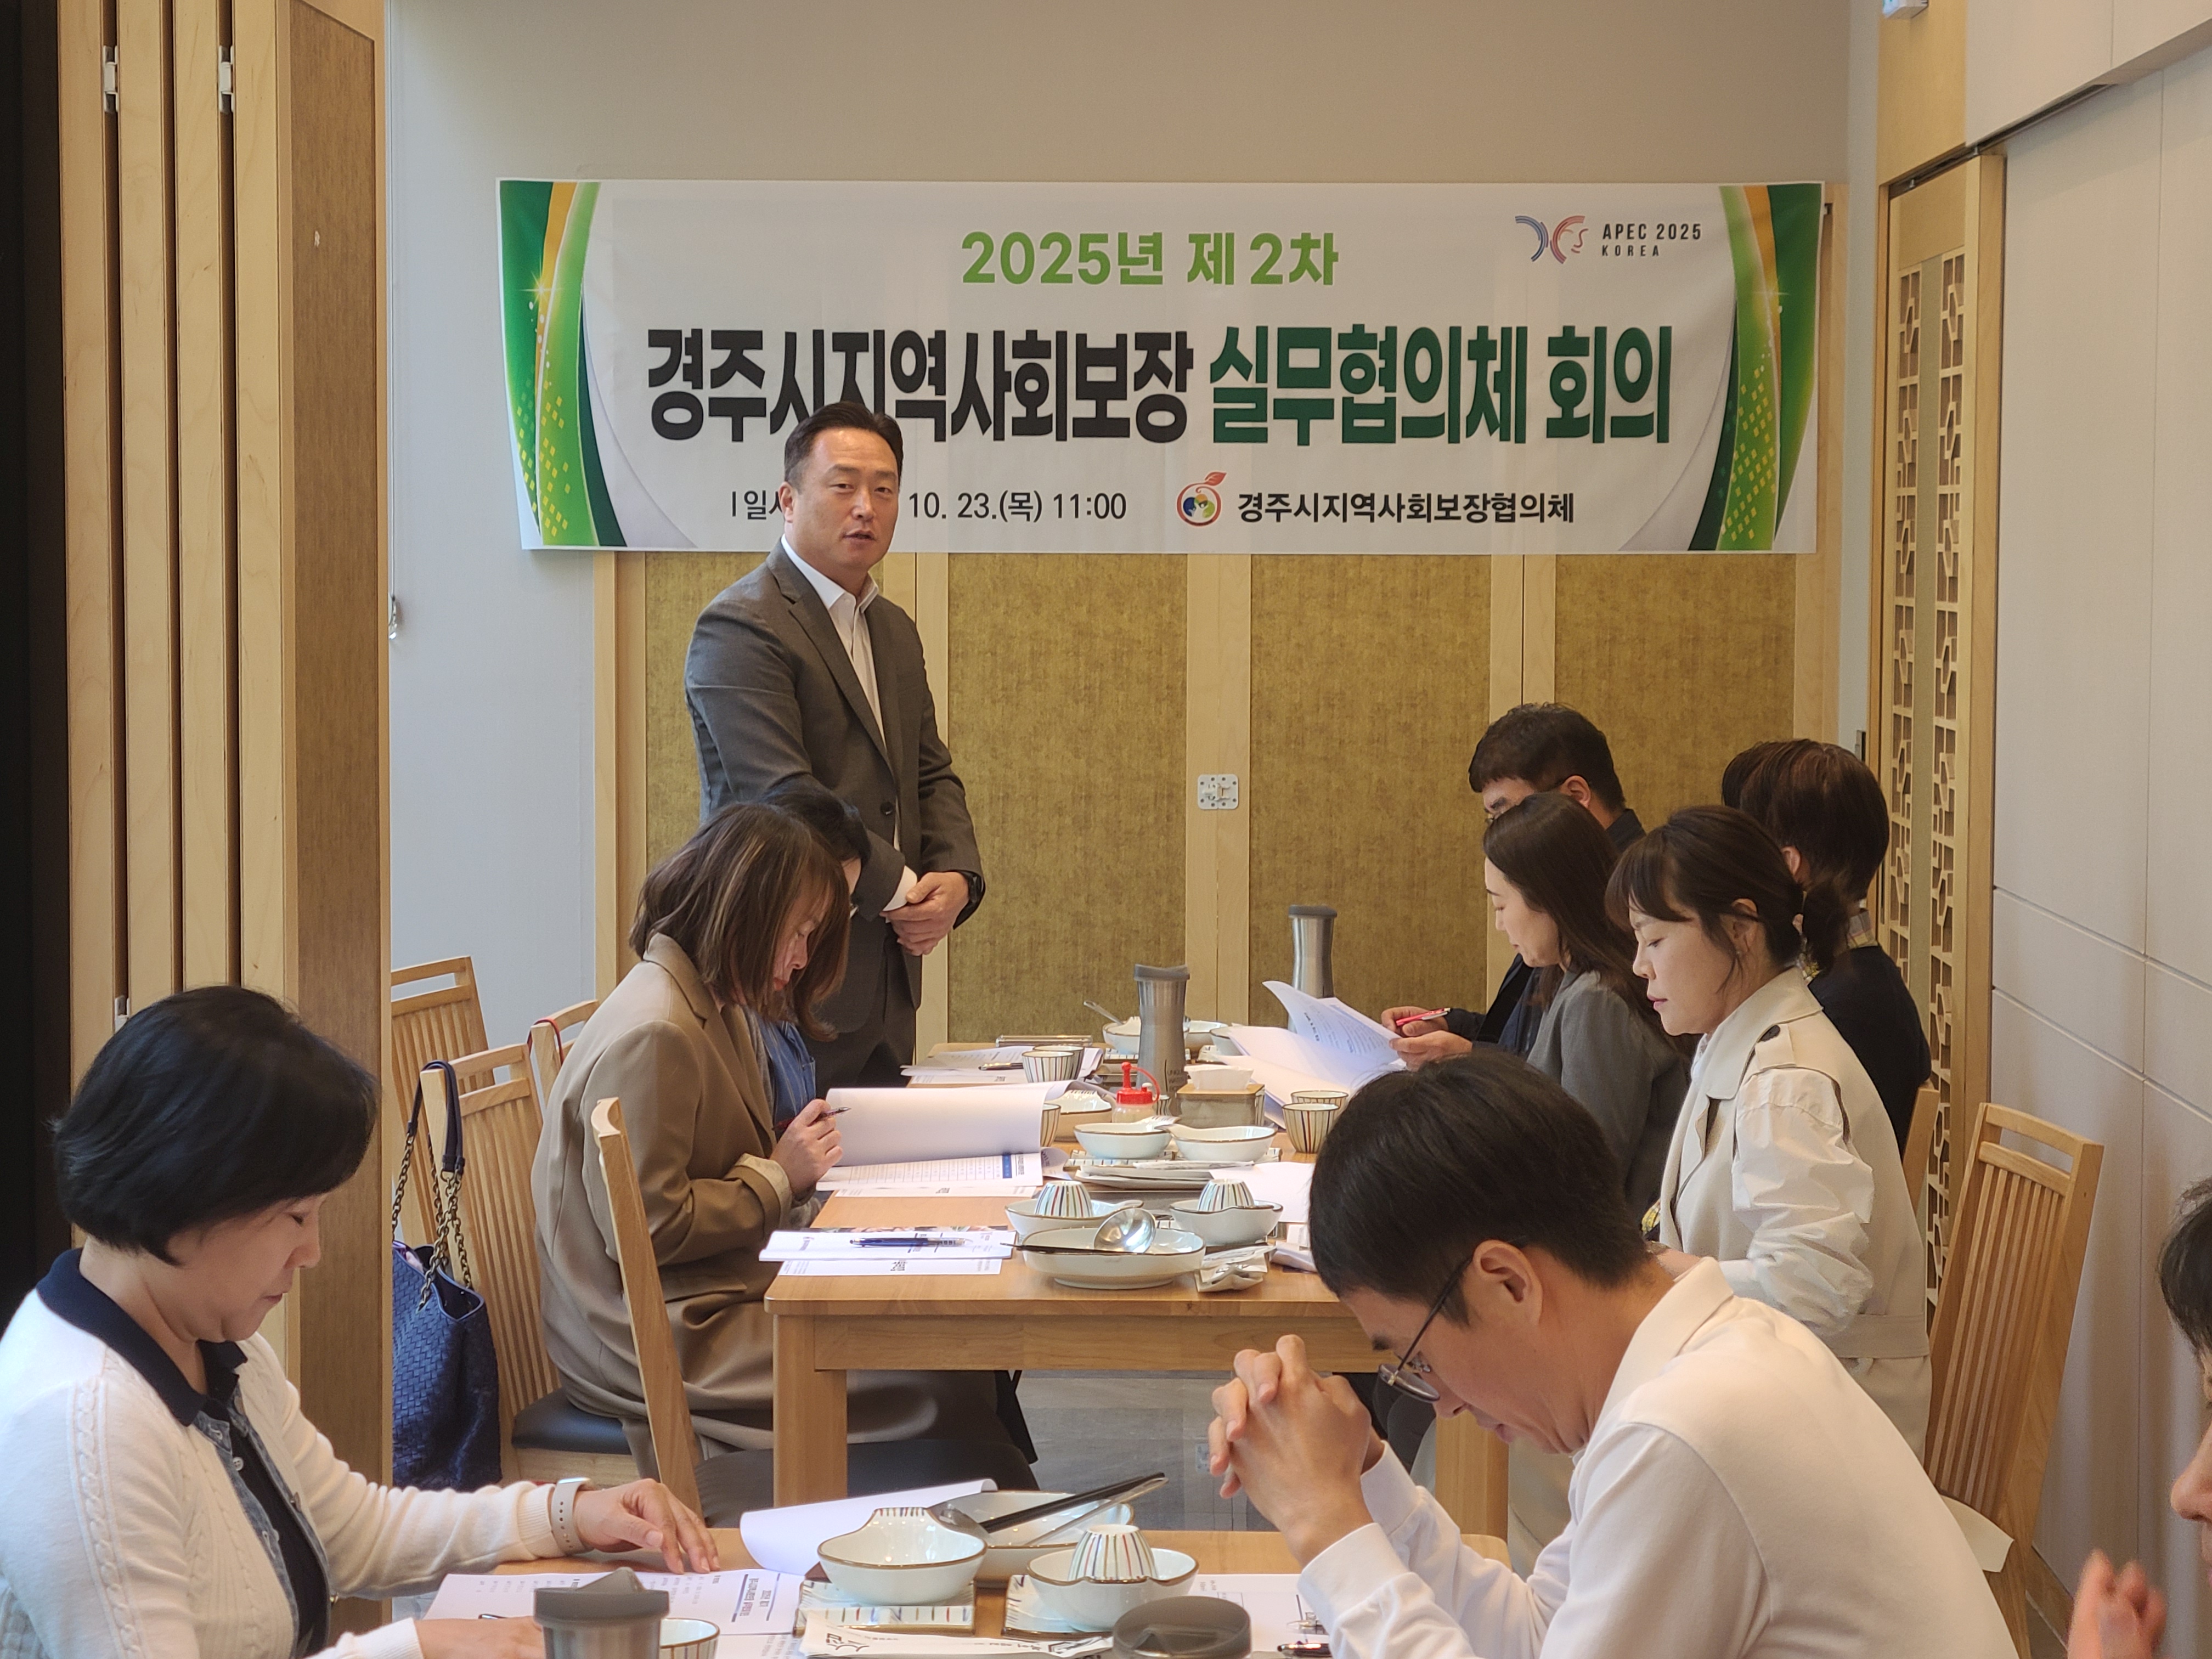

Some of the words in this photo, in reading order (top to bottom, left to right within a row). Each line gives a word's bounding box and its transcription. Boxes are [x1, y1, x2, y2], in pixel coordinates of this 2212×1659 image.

[1602, 223, 1646, 240] APEC
[1656, 223, 1701, 240] 2025
[962, 232, 1163, 285] 2025년
[1187, 233, 1234, 285] 제
[1250, 233, 1339, 285] 2차
[1602, 245, 1659, 256] KOREA
[648, 328, 1194, 444] 경주시지역사회보장
[1210, 324, 1528, 447] 실무협의체
[1545, 325, 1672, 444] 회의
[909, 492, 946, 519] 10.
[957, 490, 1042, 523] 23.(목)
[1053, 493, 1127, 520] 11:00
[1238, 492, 1575, 523] 경주시지역사회보장협의체
